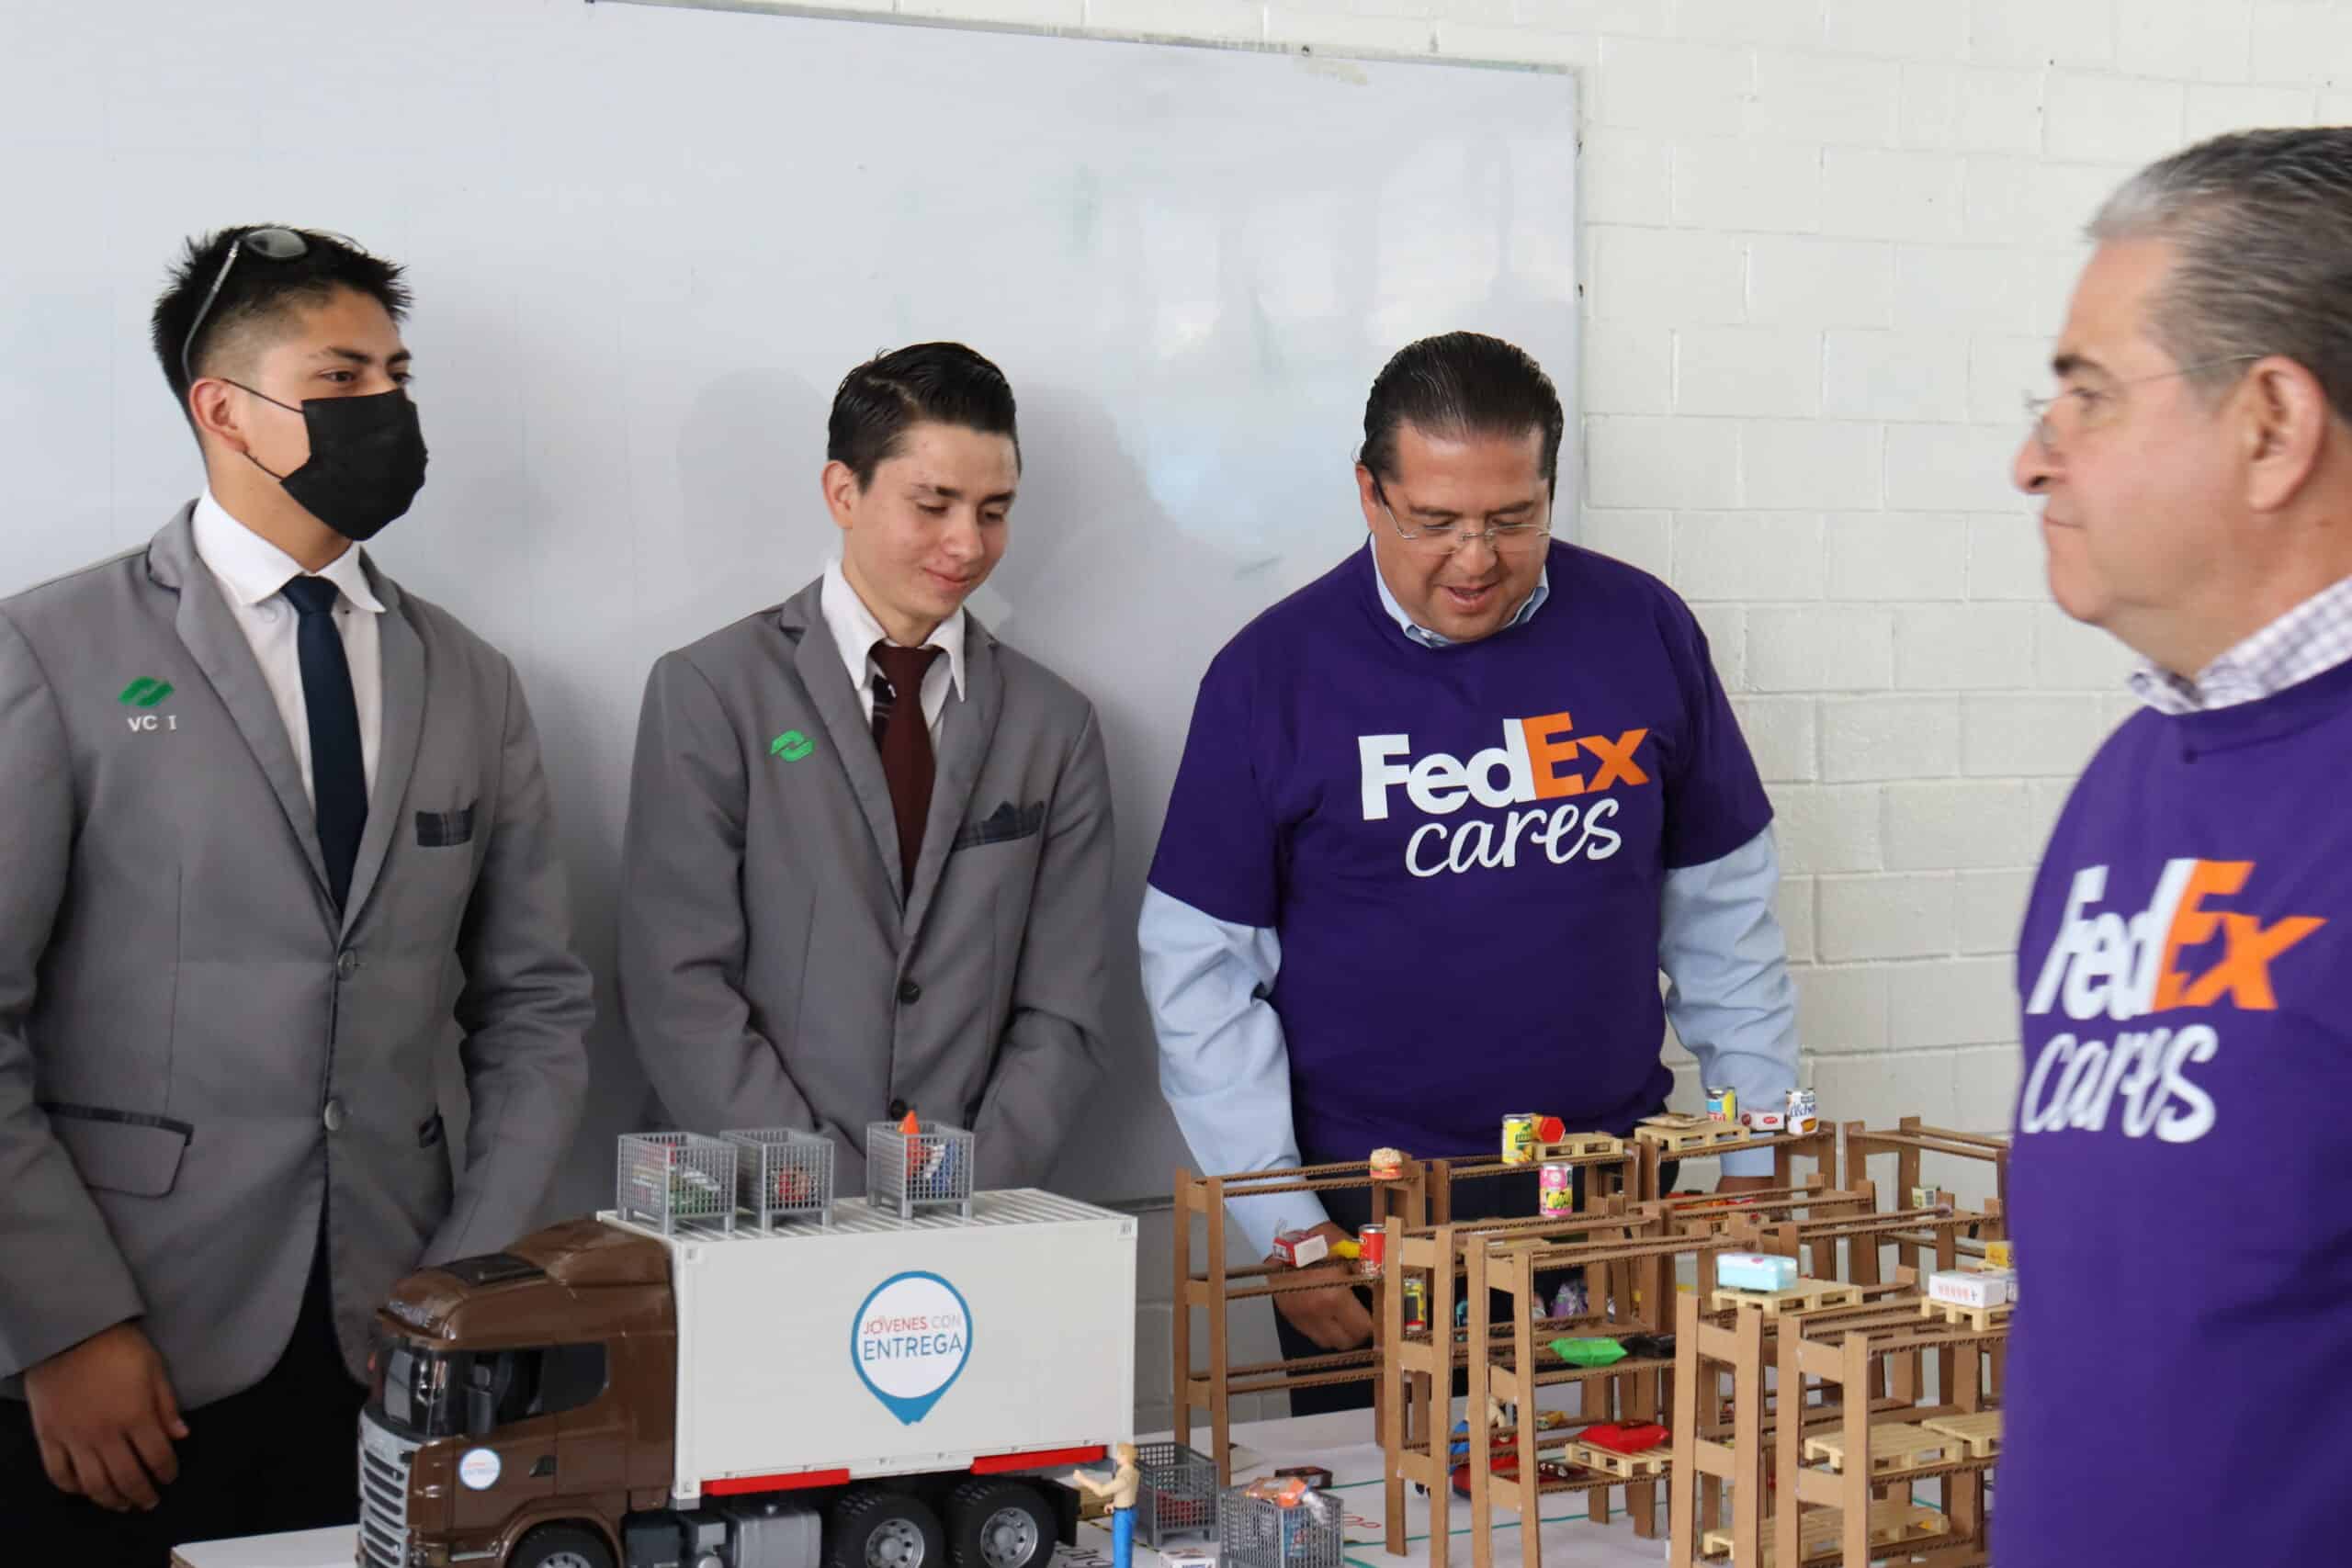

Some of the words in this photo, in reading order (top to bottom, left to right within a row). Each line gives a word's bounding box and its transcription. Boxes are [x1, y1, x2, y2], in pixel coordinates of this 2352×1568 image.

[127, 715, 158, 732] VC
[1358, 711, 1650, 820] FedEx
[1405, 797, 1622, 877] cares
[2025, 857, 2330, 1021] FedEx
[2020, 1023, 2219, 1143] cares
[864, 1332, 964, 1360] ENTREGA
[932, 1314, 962, 1329] CON
